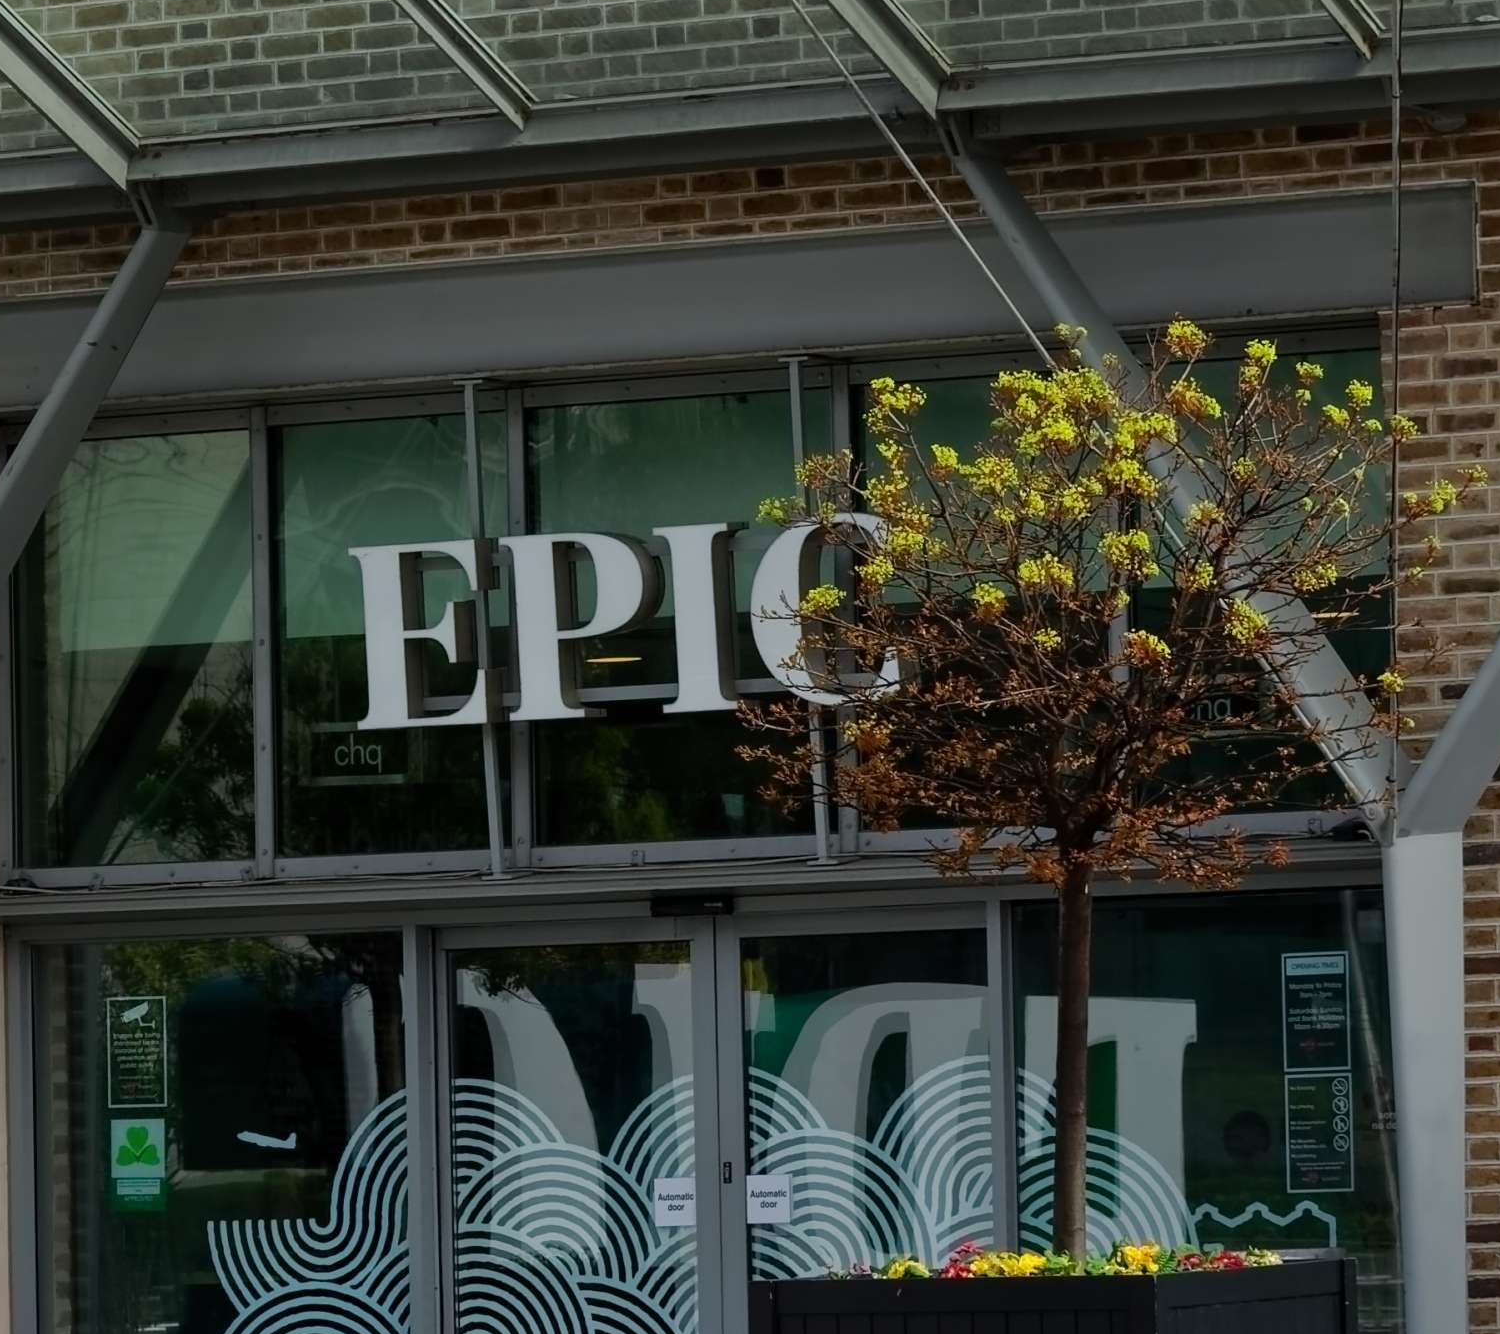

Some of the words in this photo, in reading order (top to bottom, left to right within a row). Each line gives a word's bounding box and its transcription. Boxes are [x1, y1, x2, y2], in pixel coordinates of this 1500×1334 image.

[349, 512, 902, 731] EPIC
[334, 732, 382, 774] chq
[657, 1192, 694, 1202] Automatic
[750, 1188, 787, 1199] Automatic
[667, 1203, 685, 1211] door
[760, 1200, 777, 1209] door
